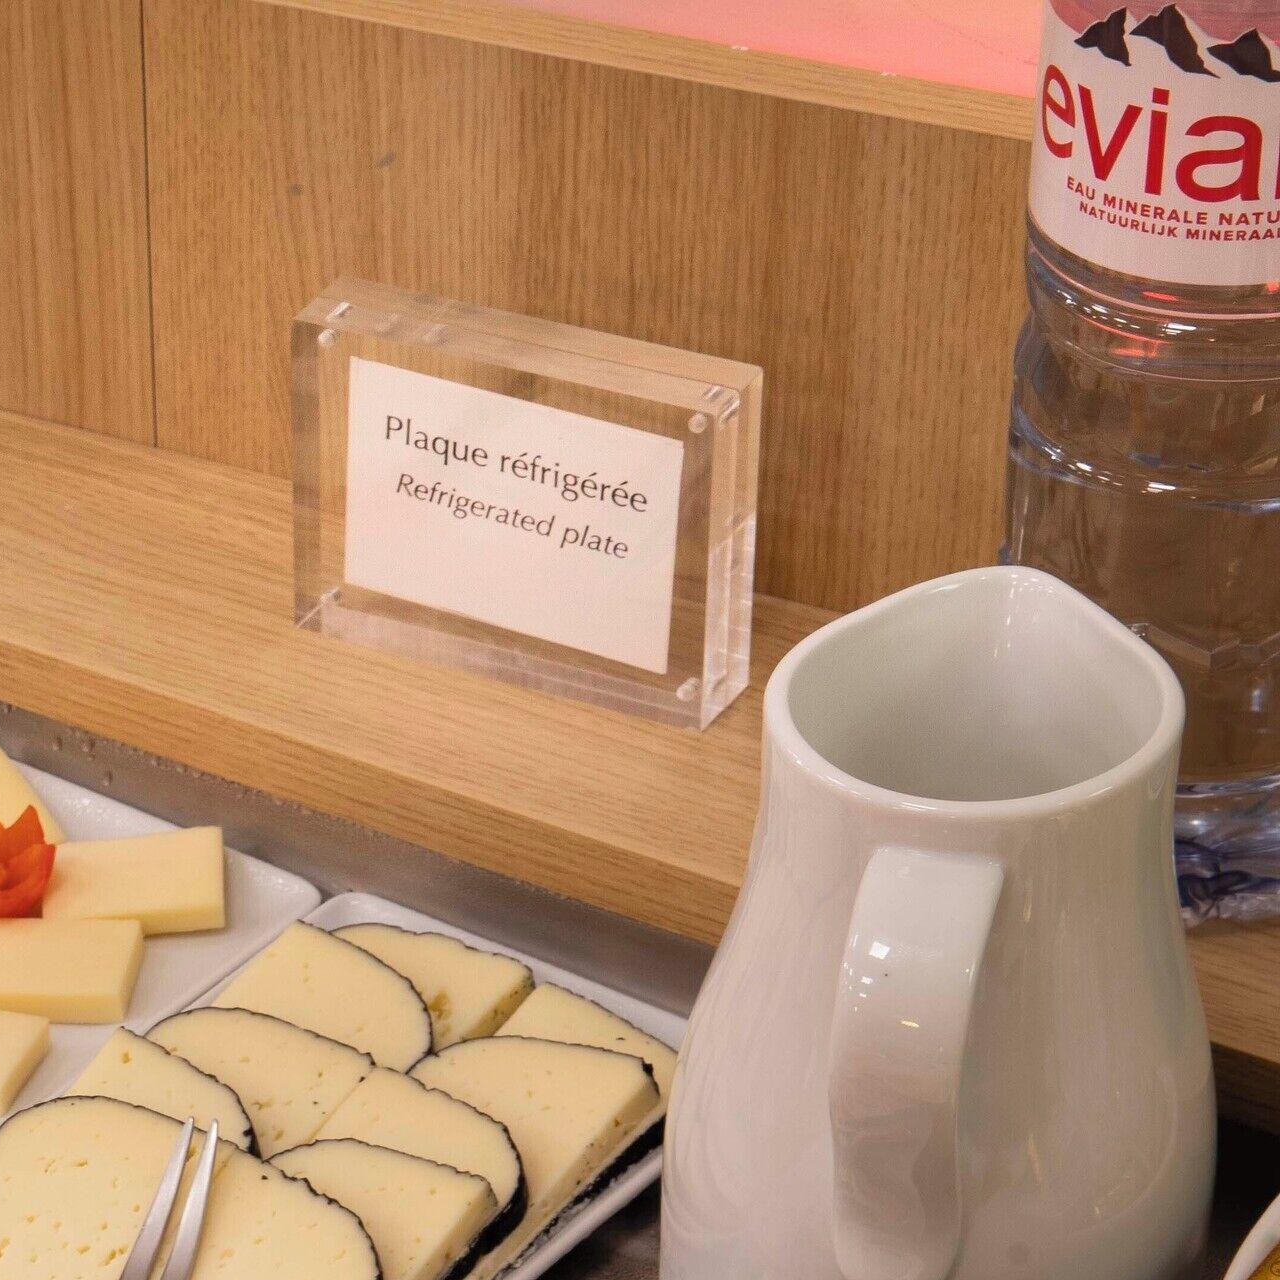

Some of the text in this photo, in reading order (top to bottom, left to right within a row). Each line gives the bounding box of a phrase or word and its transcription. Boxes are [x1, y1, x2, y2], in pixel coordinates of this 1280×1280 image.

[1042, 64, 1280, 203] evia
[1066, 175, 1096, 201] EAU
[1103, 193, 1208, 225] MINERALE
[1079, 201, 1178, 238] NATUURLIJK
[384, 414, 649, 513] Plaque réfrigérée
[396, 473, 630, 560] Refrigerated plate
